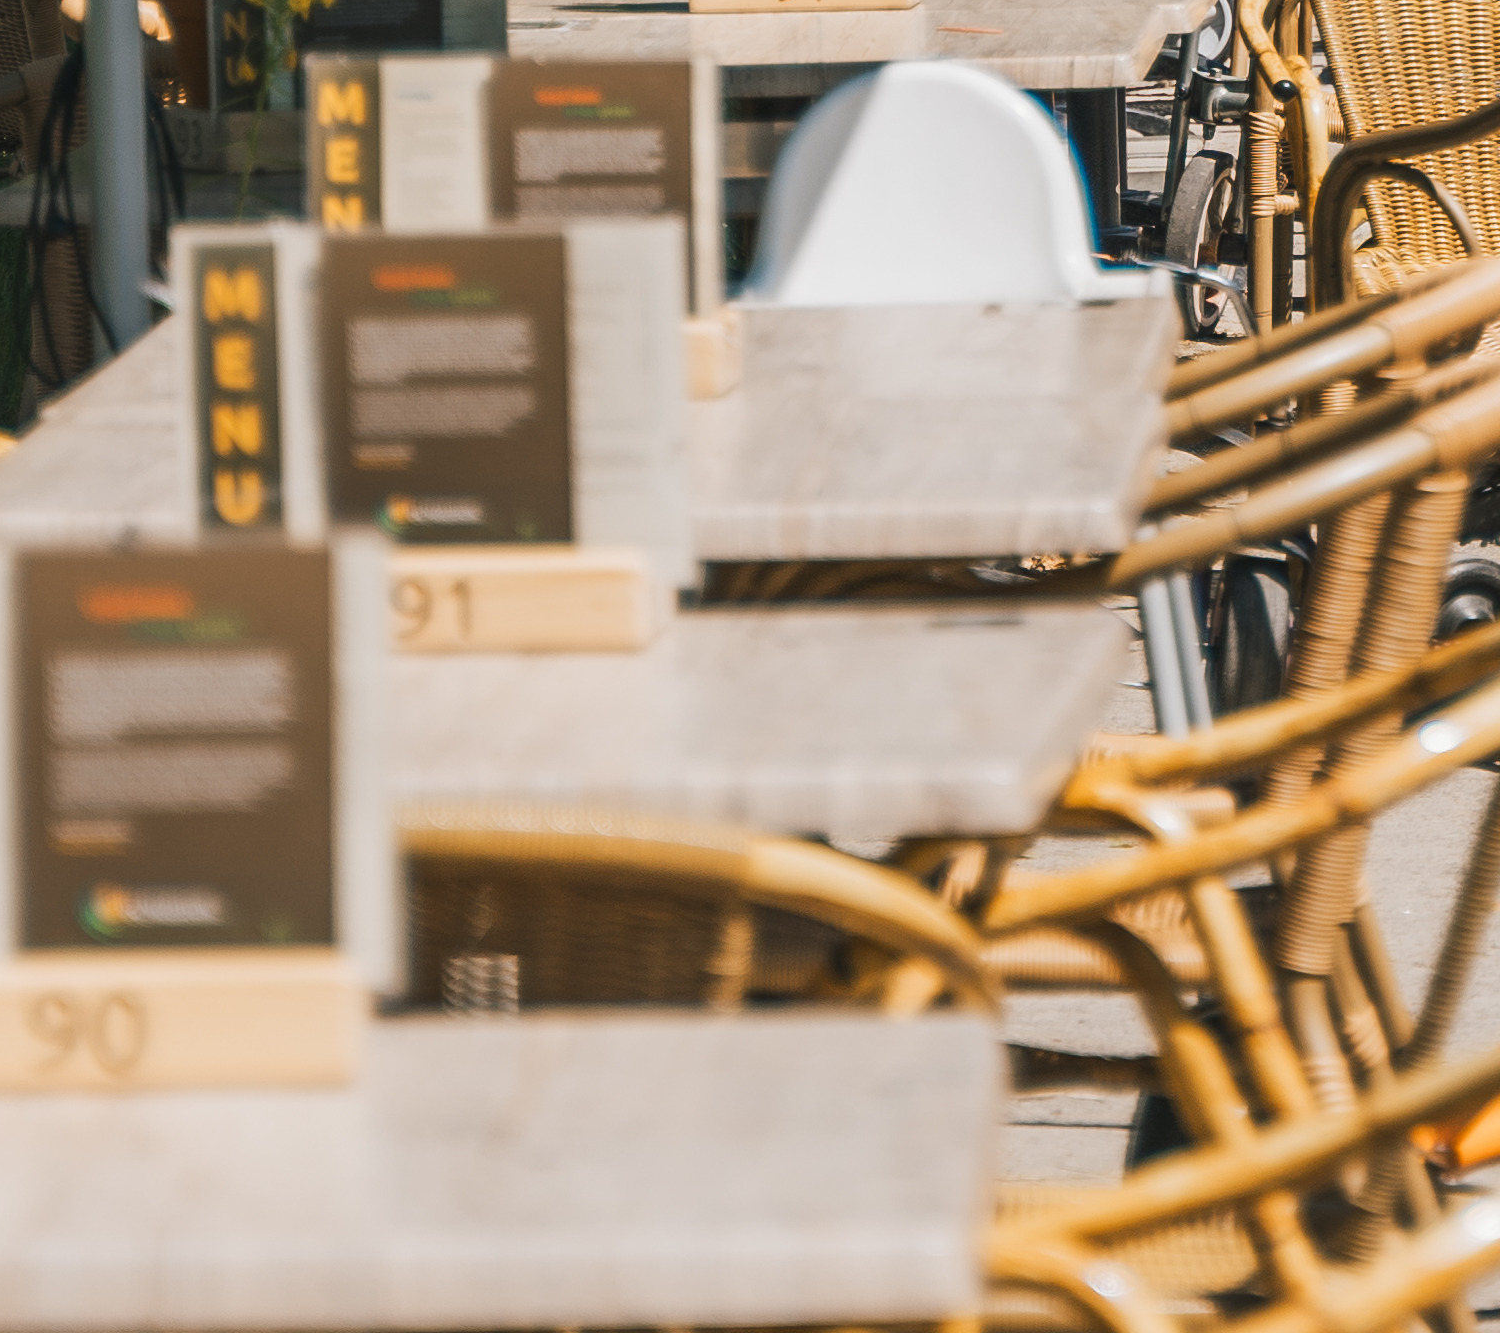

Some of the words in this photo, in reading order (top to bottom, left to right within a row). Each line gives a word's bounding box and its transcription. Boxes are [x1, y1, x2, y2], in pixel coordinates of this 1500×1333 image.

[316, 79, 367, 233] MEN
[203, 265, 263, 526] MENU
[391, 576, 474, 642] 91
[23, 991, 148, 1080] 90
